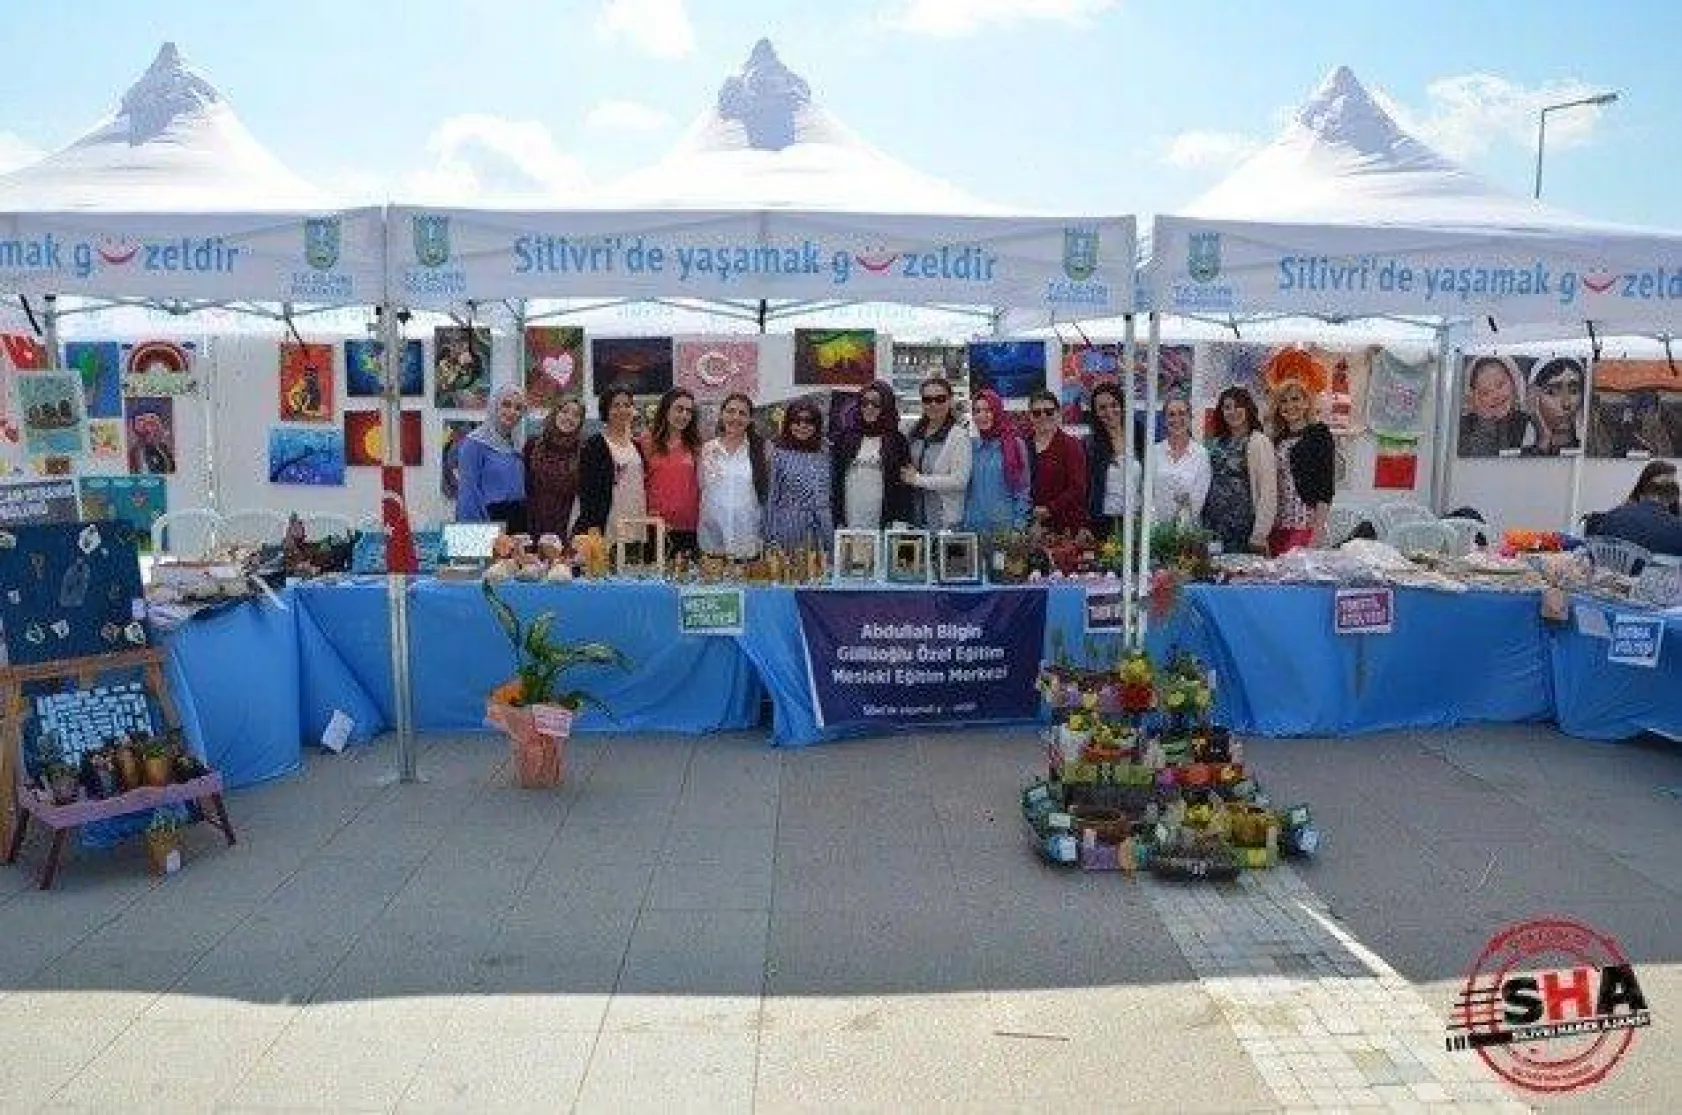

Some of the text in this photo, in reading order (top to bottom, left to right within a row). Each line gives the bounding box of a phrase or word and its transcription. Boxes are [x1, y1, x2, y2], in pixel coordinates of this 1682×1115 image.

[515, 235, 664, 274] Silivri'de
[678, 241, 821, 281] yaşamak
[1279, 255, 1412, 293] Silivri'de
[1424, 263, 1549, 301] yaşamak
[860, 622, 933, 639] Abdullah
